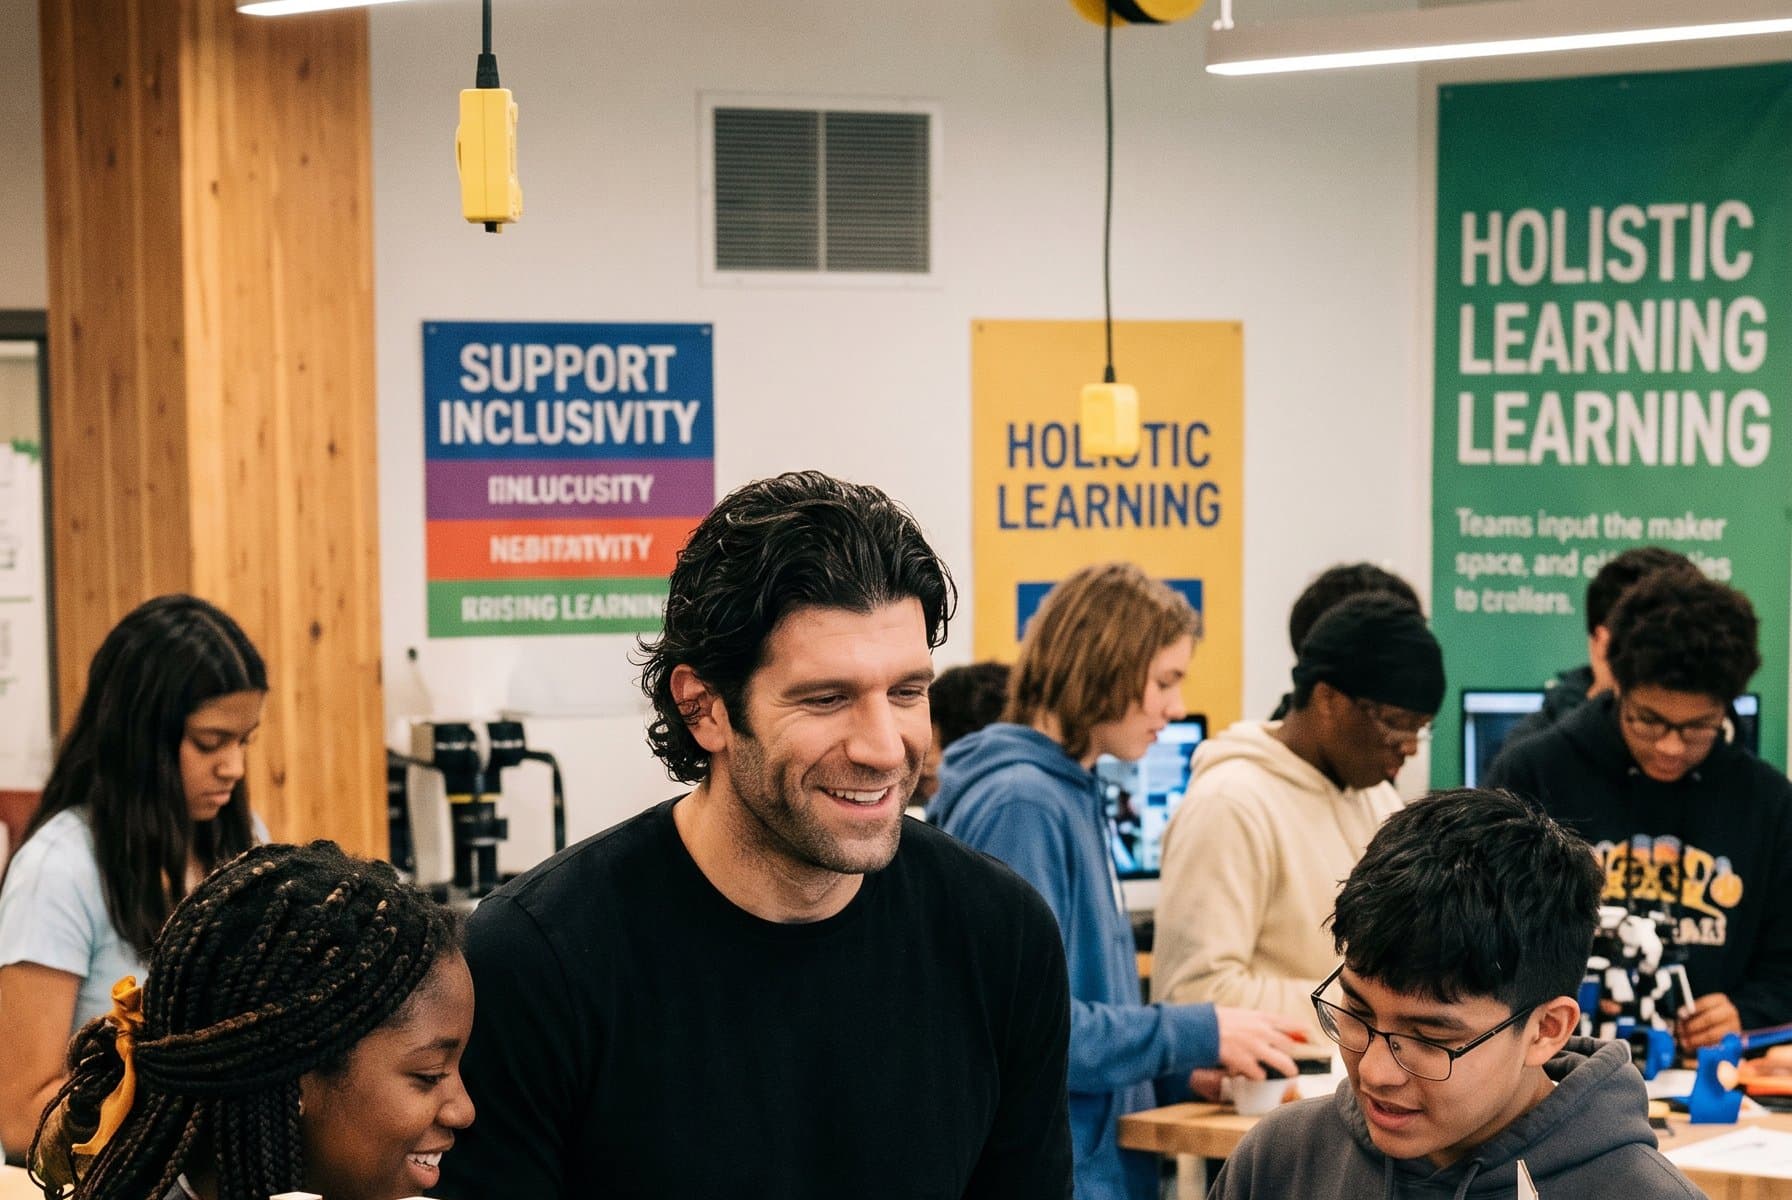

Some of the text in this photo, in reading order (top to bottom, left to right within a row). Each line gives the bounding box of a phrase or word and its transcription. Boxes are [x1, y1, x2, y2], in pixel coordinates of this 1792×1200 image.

[1461, 201, 1754, 286] HOLISTIC
[1459, 297, 1767, 374] LEARNING
[460, 343, 676, 393] SUPPORT
[440, 400, 700, 445] INCLUSIVITY
[1457, 390, 1772, 467] LEARNING
[997, 481, 1221, 529] LEARNING
[1456, 508, 1728, 545] Teams input the maker
[1533, 550, 1578, 577] and
[1455, 587, 1478, 612] to
